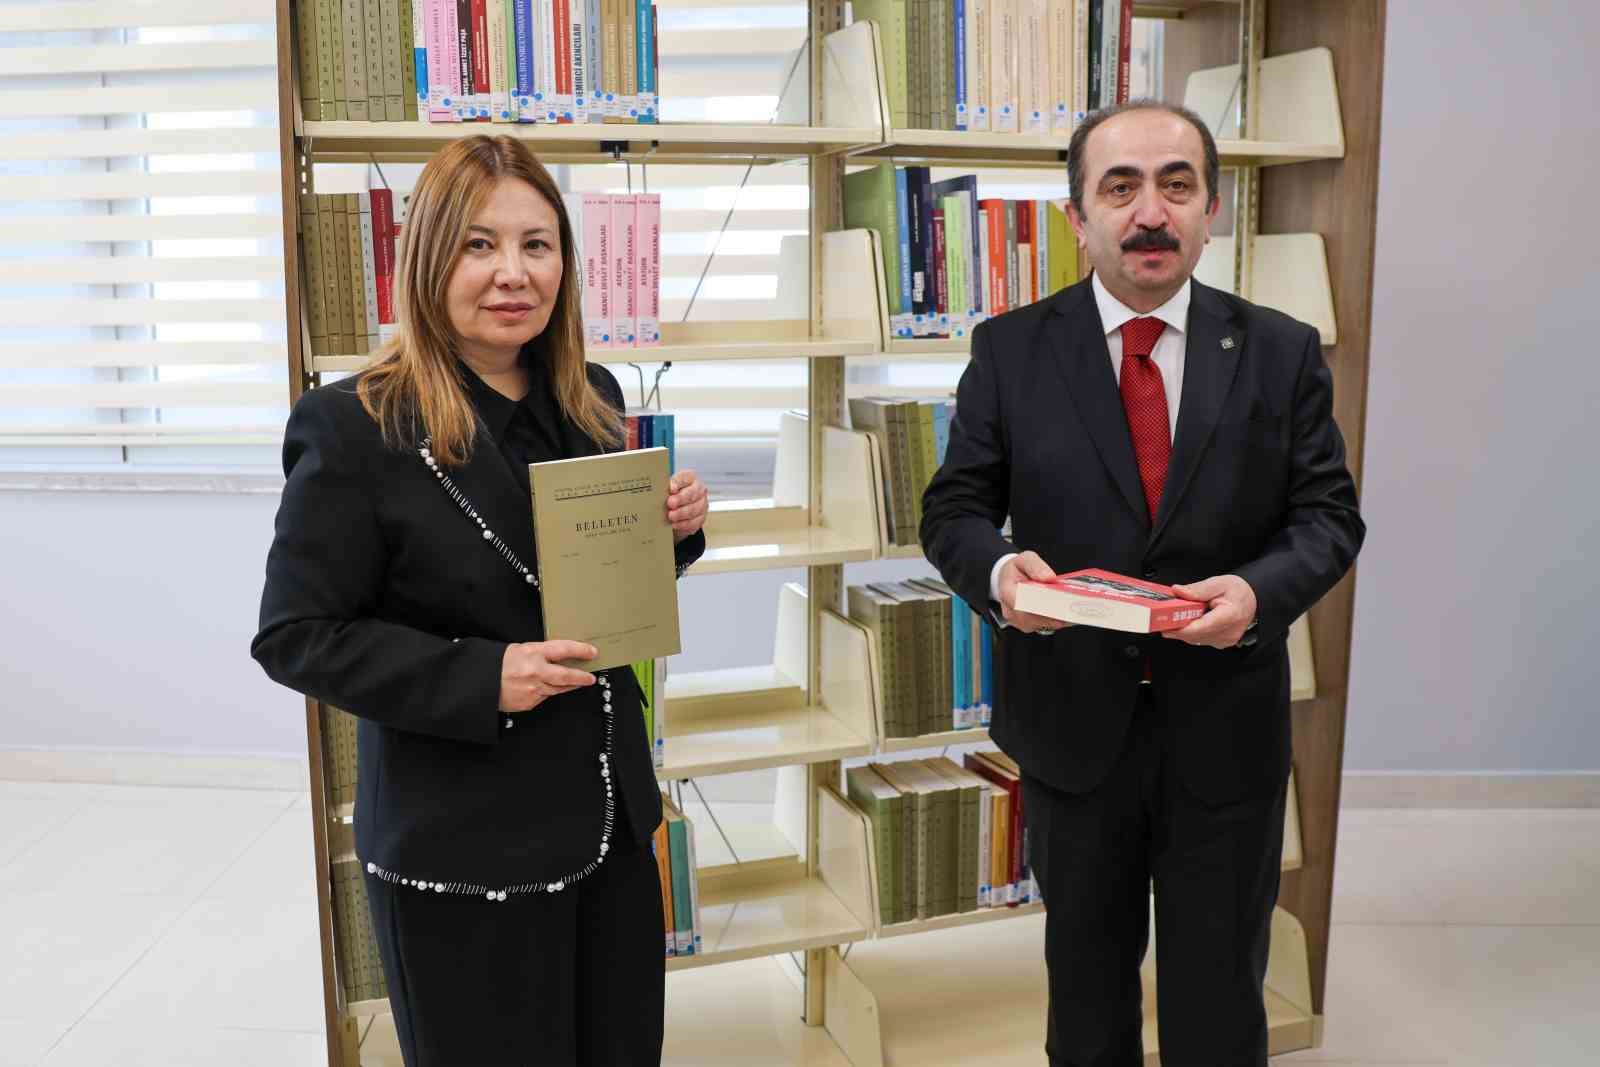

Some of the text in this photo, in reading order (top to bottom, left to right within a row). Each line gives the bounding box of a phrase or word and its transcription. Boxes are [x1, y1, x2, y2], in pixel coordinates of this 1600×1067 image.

[573, 24, 583, 97] EMİRCİ AKINCILARI
[576, 513, 639, 532] BELLETEN
